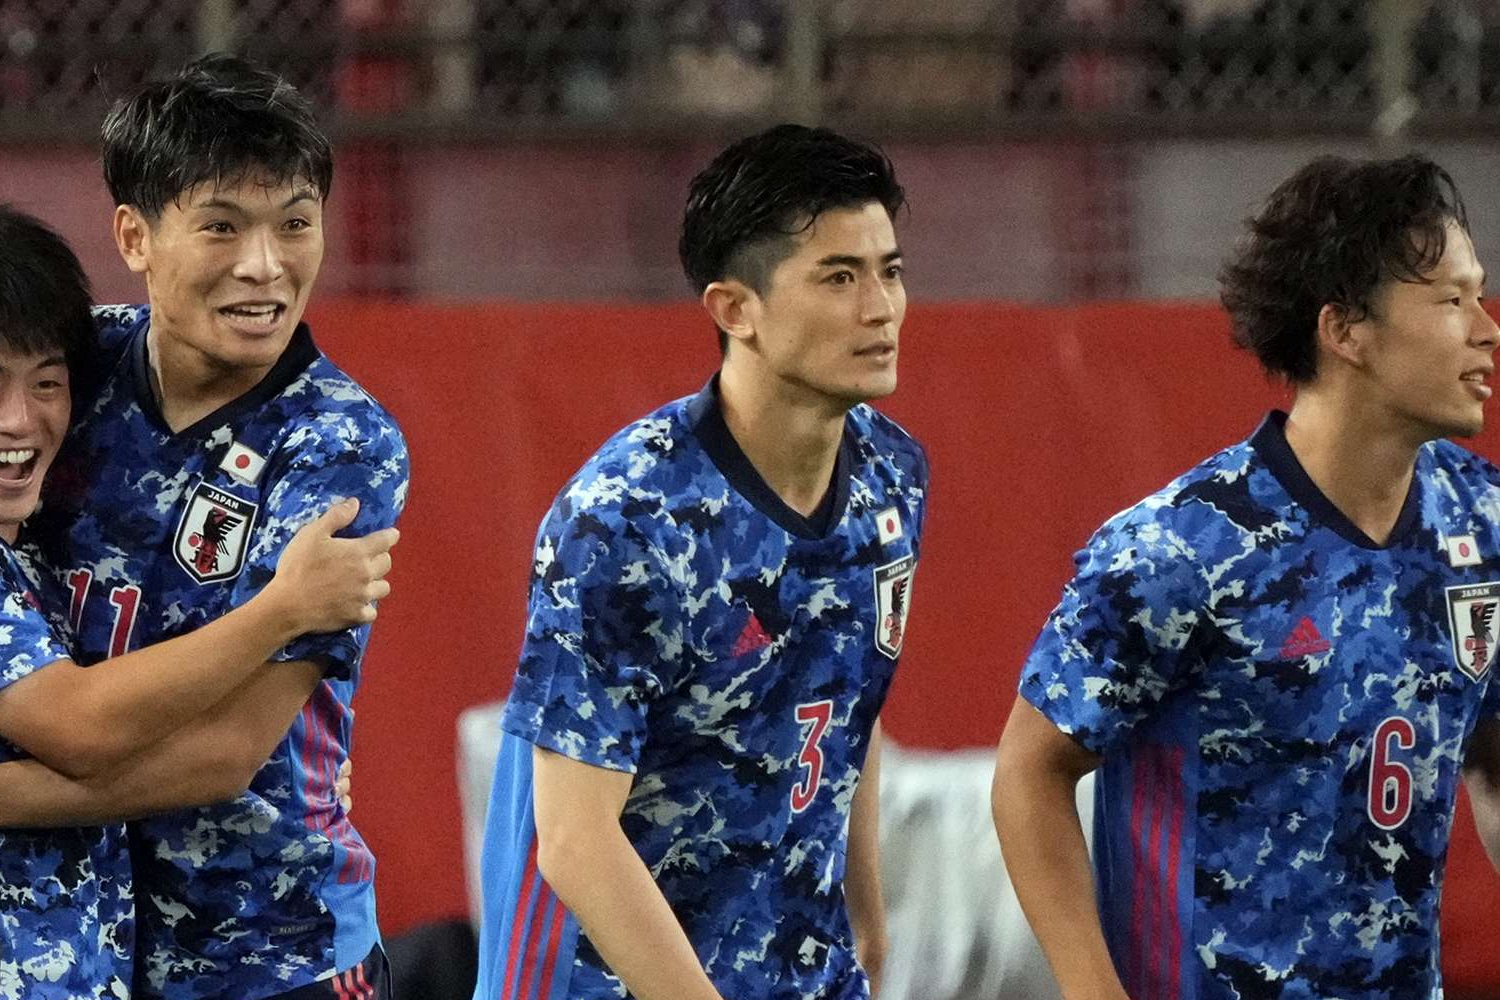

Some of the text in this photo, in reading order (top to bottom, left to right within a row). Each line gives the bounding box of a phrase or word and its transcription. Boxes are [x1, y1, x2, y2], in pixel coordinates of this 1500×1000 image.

[208, 490, 240, 510] JAPAN
[1461, 587, 1491, 598] JAPAN
[790, 699, 834, 814] 3
[1367, 715, 1416, 831] 6
